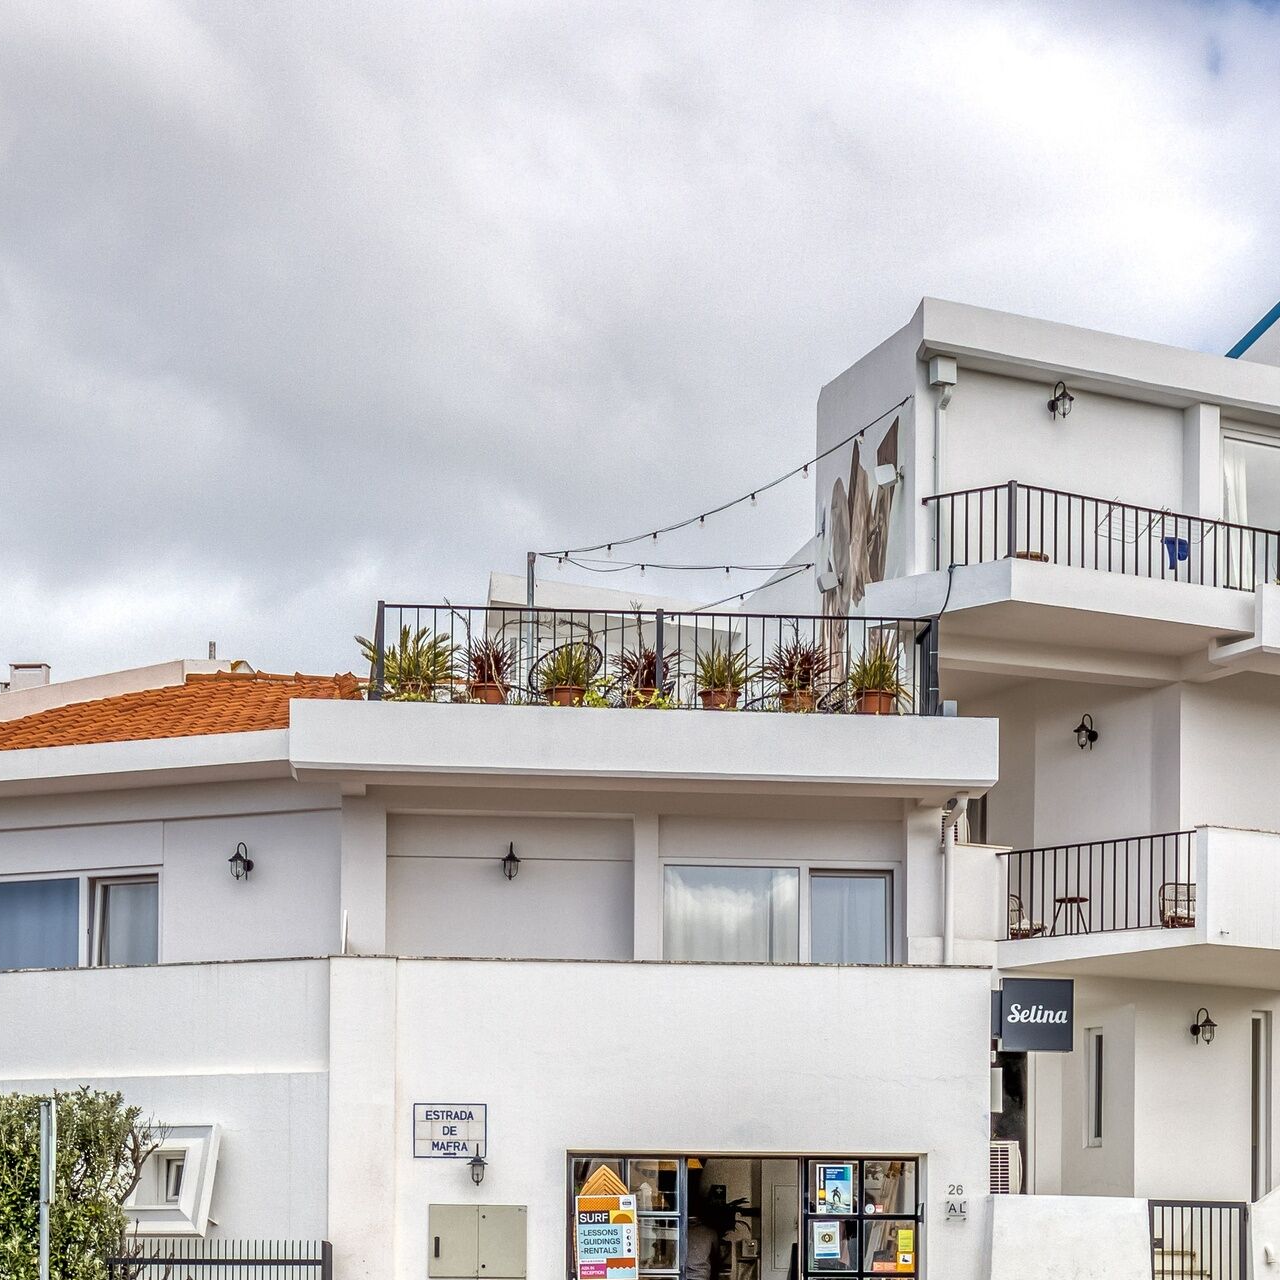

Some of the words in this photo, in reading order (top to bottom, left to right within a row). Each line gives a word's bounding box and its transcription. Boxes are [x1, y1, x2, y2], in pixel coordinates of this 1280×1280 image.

[1007, 1003, 1068, 1024] Selina
[425, 1110, 474, 1120] ESTRADA
[442, 1126, 457, 1136] DE
[431, 1141, 468, 1151] MAFRA
[948, 1184, 964, 1195] 26
[948, 1203, 966, 1213] AL
[579, 1213, 608, 1223] SURF
